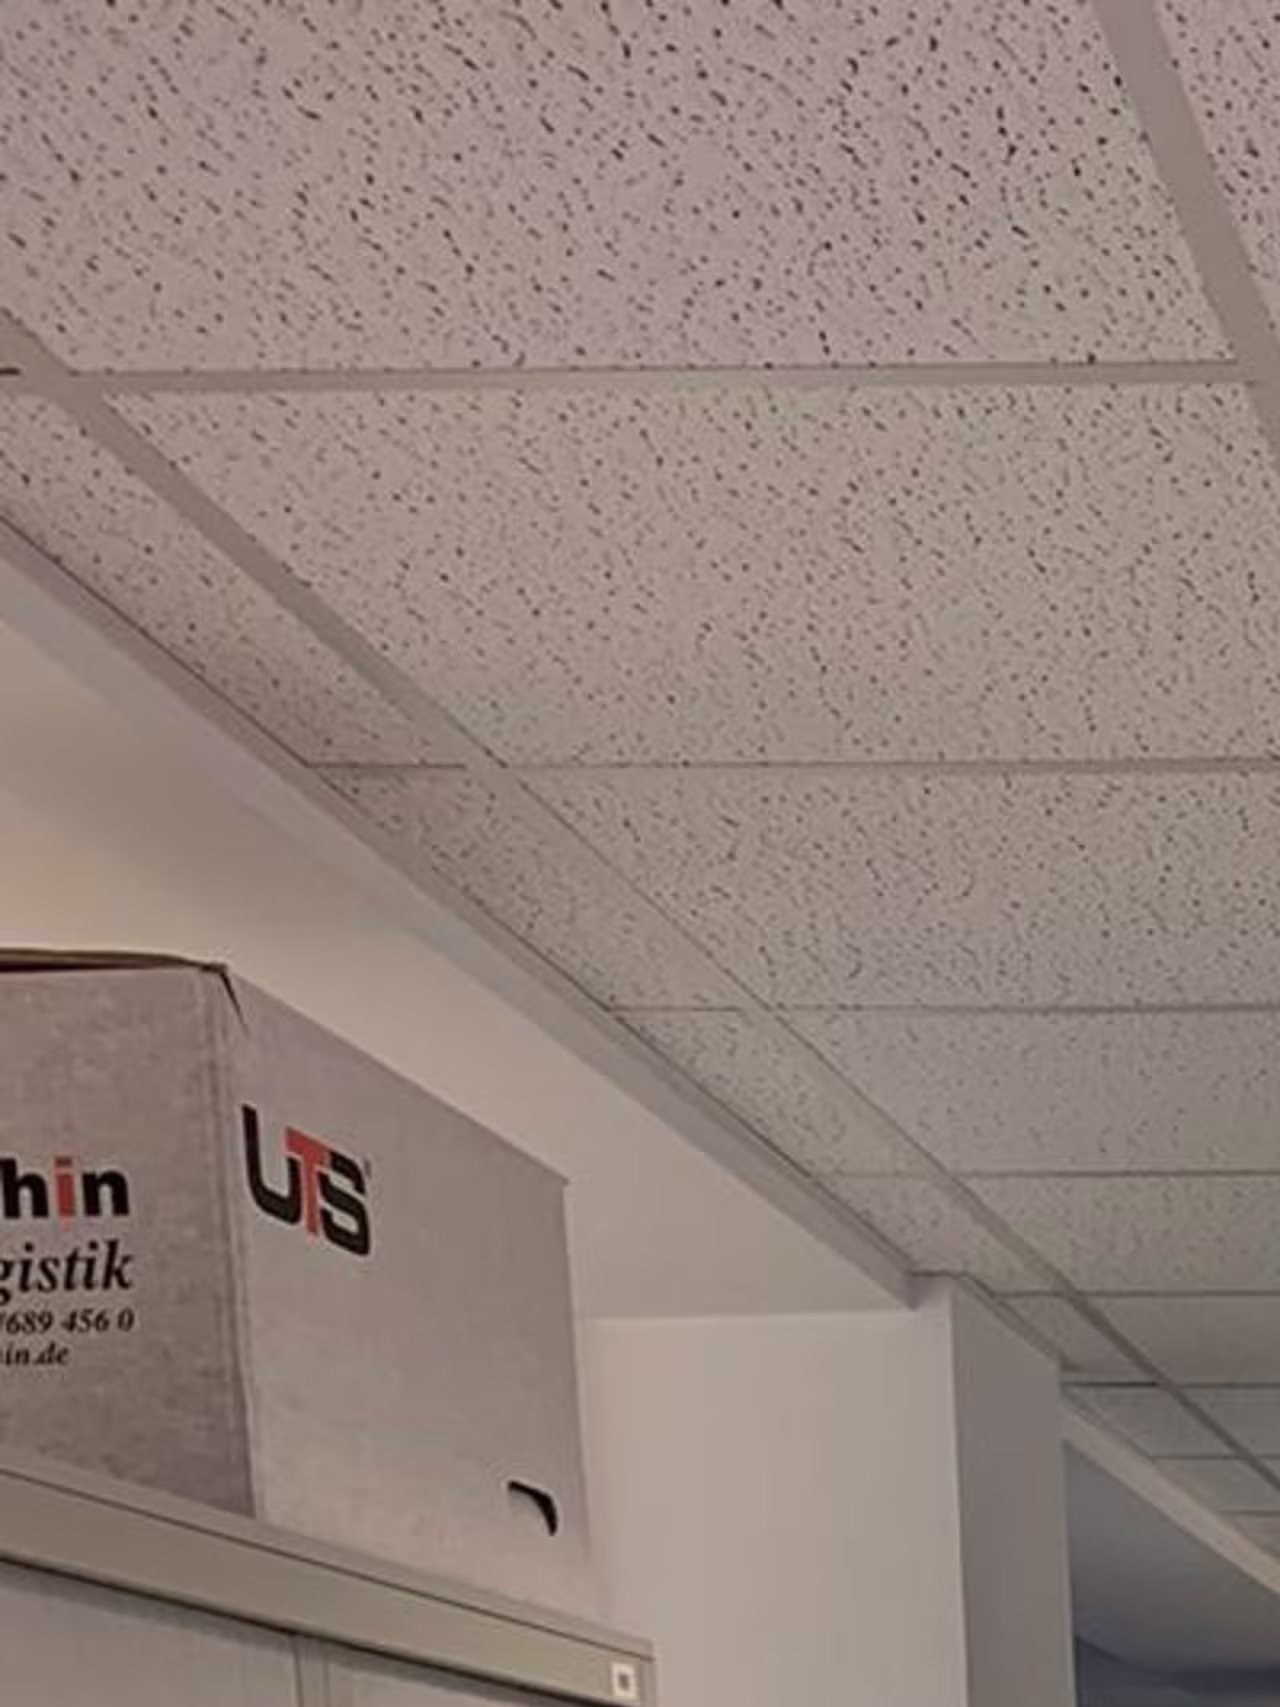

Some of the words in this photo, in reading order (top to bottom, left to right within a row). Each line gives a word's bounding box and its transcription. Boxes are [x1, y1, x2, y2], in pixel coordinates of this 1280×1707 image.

[241, 1103, 370, 1257] UTS
[0, 1310, 53, 1335] 689
[61, 1308, 110, 1333] 456
[117, 1308, 135, 1332] 0
